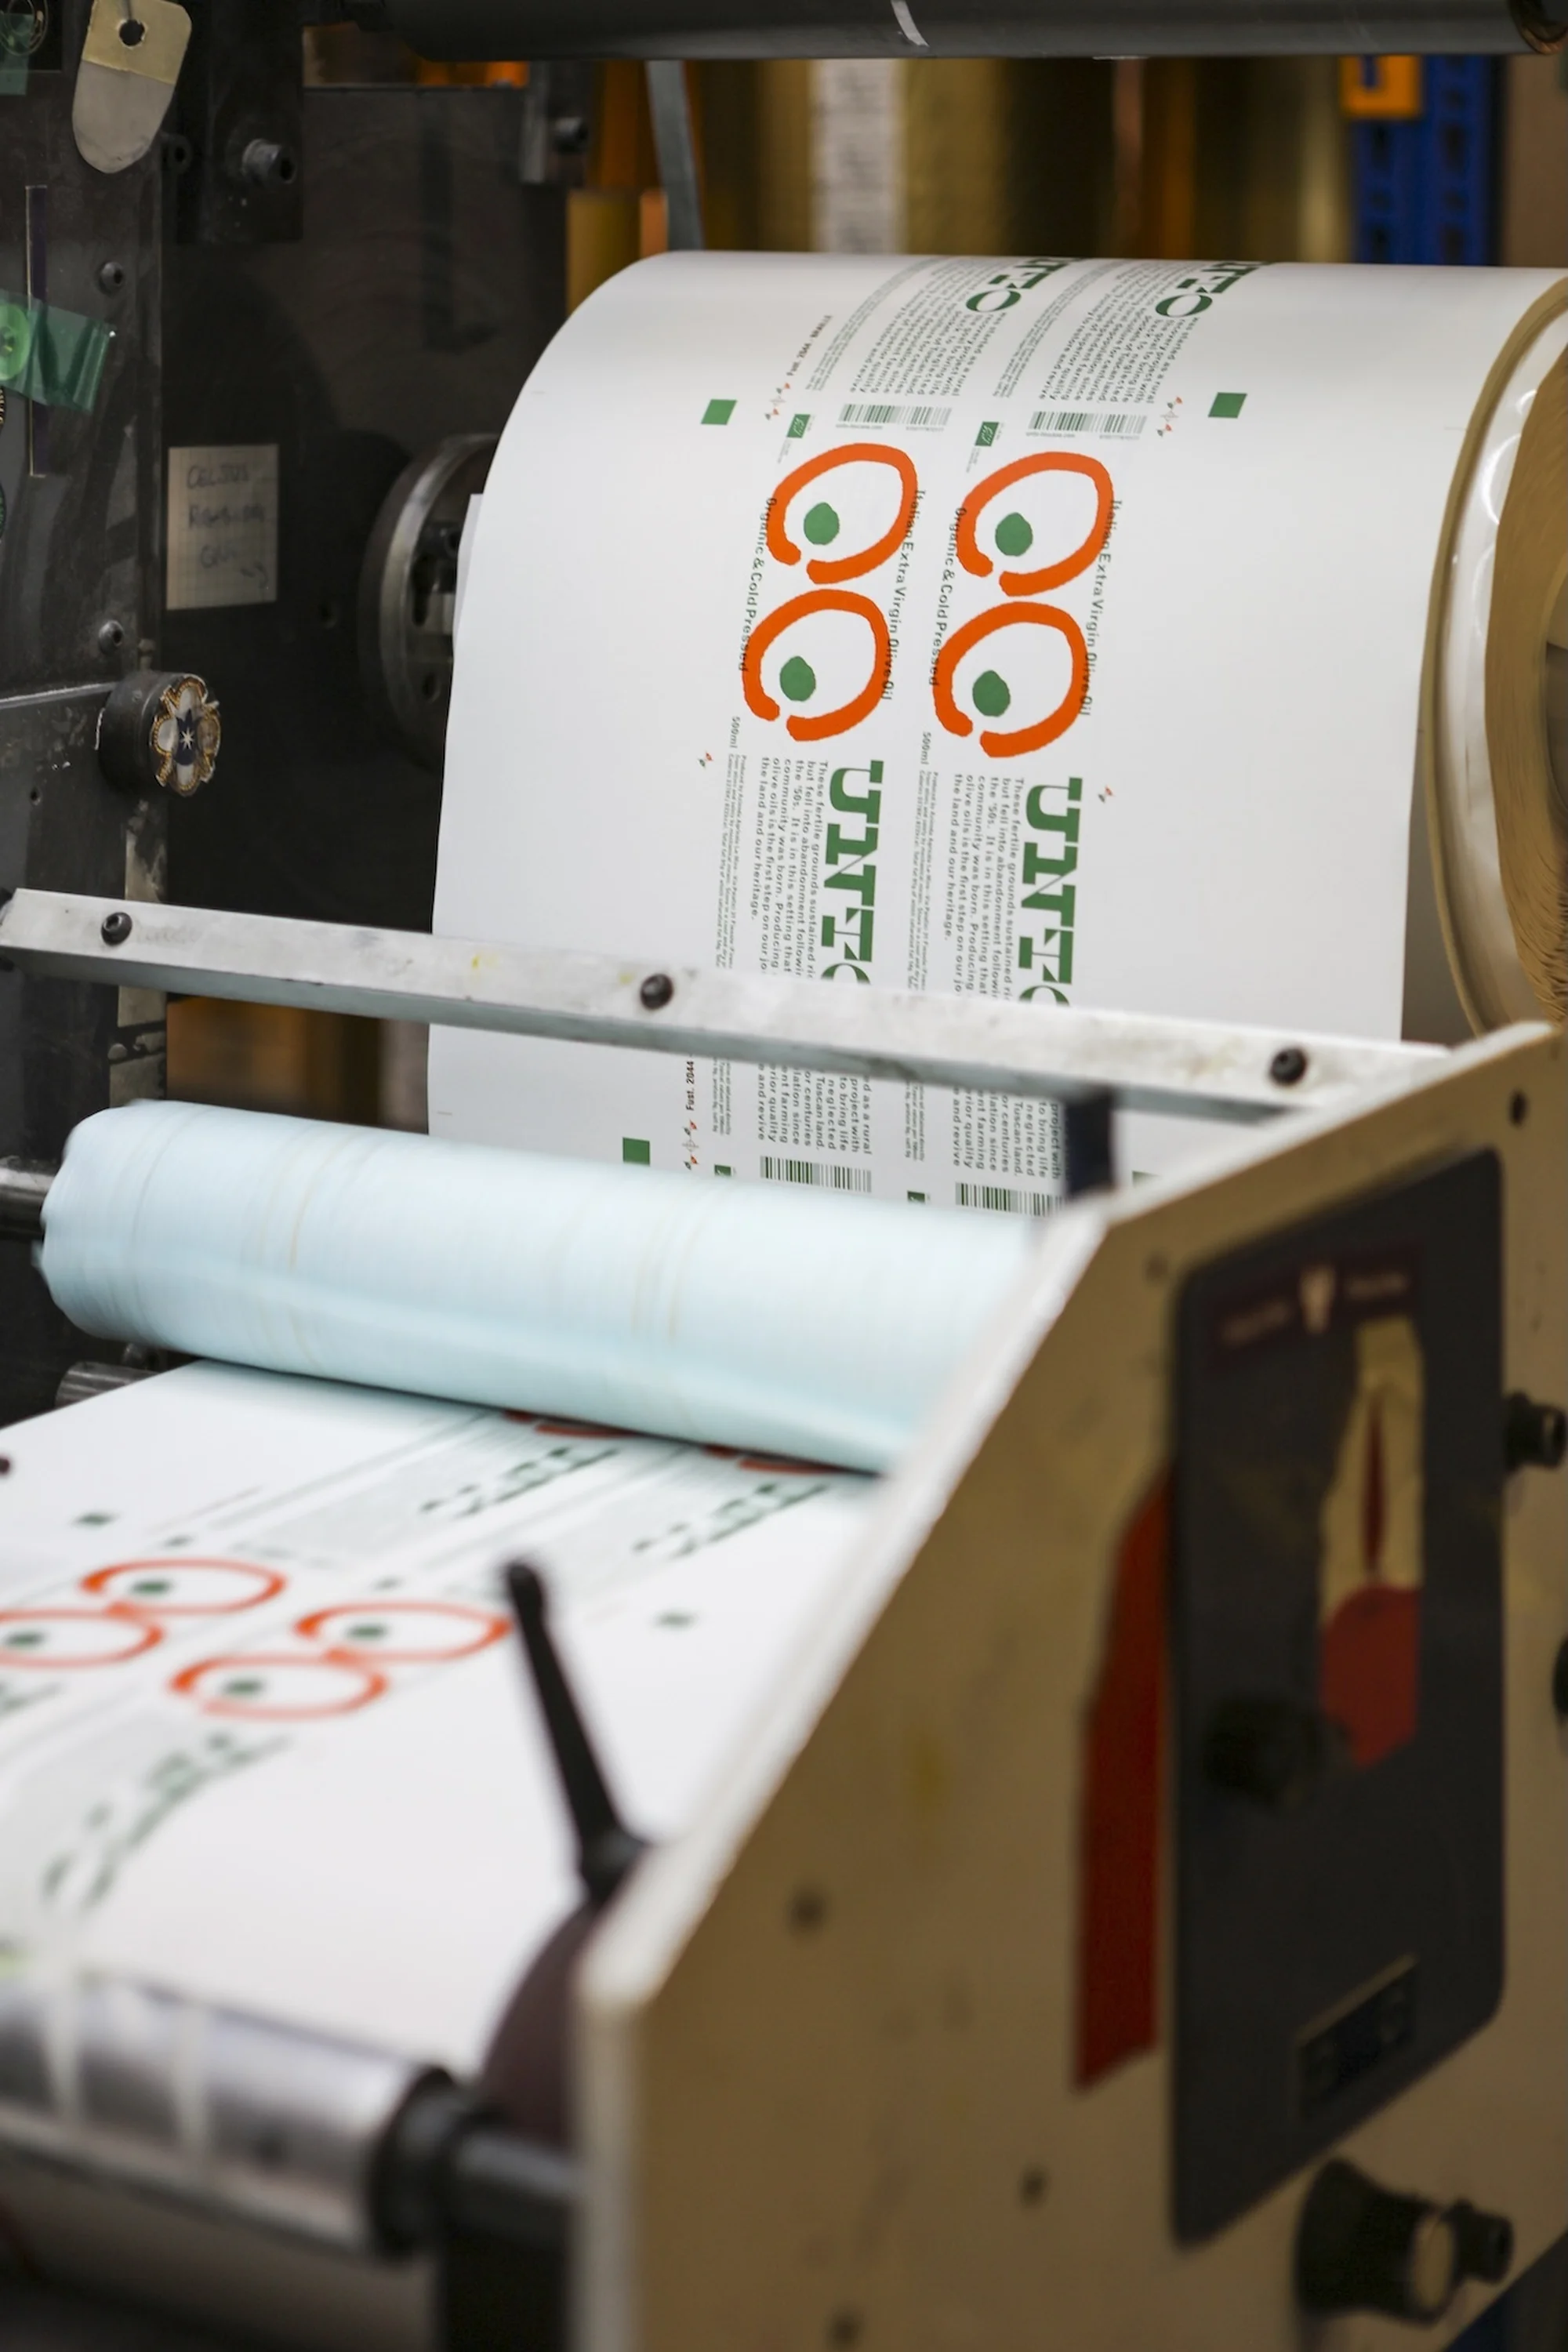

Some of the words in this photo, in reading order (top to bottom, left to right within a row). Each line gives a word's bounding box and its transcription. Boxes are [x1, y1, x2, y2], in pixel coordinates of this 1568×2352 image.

[750, 496, 778, 554] Organic
[903, 489, 927, 538] Italian
[1100, 499, 1123, 550] Italian
[941, 506, 967, 566] Organic
[751, 557, 764, 571] &
[894, 541, 915, 583] Extra
[942, 568, 954, 582] &
[1091, 553, 1112, 596] Extra
[746, 571, 762, 606] Cold
[936, 583, 953, 619] Cold
[886, 585, 906, 633] Virgin
[1083, 597, 1105, 648] Virgin
[737, 608, 756, 672] Pressed
[927, 621, 947, 687] Pressed
[884, 637, 898, 678] Olive
[1082, 652, 1097, 691] Olive
[880, 680, 895, 700] Oil
[1078, 695, 1093, 716] Oil
[729, 716, 740, 748] 500ml
[920, 731, 931, 764] 500ml
[760, 757, 769, 777] the
[771, 757, 781, 789] olive
[794, 760, 804, 780] the
[806, 760, 816, 781] but
[816, 761, 828, 797] These
[757, 780, 768, 808] land
[777, 758, 790, 832] community
[804, 786, 814, 806] fell
[953, 774, 963, 793] the
[964, 775, 974, 806] olive
[989, 777, 999, 797] the
[1001, 778, 1011, 798] but
[1012, 778, 1024, 815] These
[768, 792, 778, 815] oils
[950, 797, 961, 826] land
[971, 775, 985, 850] community
[1000, 804, 1010, 823] fell
[768, 818, 777, 829] is
[791, 818, 800, 826] It
[802, 809, 811, 833] into
[813, 801, 825, 839] fertile
[962, 810, 971, 833] oils
[766, 832, 775, 852] the
[789, 831, 799, 843] is
[949, 829, 957, 854] and
[961, 837, 969, 848] is
[985, 836, 995, 845] It
[997, 827, 1007, 852] into
[1009, 819, 1021, 858] fertile
[764, 855, 775, 880] first
[789, 848, 797, 859] in
[810, 844, 819, 895] grounds
[960, 851, 969, 871] the
[985, 850, 993, 862] is
[775, 865, 785, 897] born.
[787, 865, 797, 889] this
[797, 837, 809, 924] abandonment
[958, 875, 968, 900] first
[984, 866, 993, 879] in
[750, 862, 762, 919] heritage.
[761, 884, 771, 911] step
[967, 884, 980, 918] born.
[982, 884, 992, 909] this
[993, 855, 1005, 945] abandonment
[1007, 862, 1015, 916] grounds
[762, 914, 769, 930] on
[782, 894, 794, 941] setting
[943, 882, 956, 939] heritage.
[956, 904, 966, 932] step
[770, 902, 783, 967] Producing
[807, 898, 817, 961] sustained
[956, 935, 963, 951] on
[978, 914, 989, 962] setting
[783, 946, 792, 972] that
[964, 923, 978, 990] Producing
[1004, 919, 1013, 983] sustained
[979, 967, 988, 994] that
[685, 1061, 694, 1084] 2044
[757, 1074, 766, 1098] and
[839, 1076, 848, 1089] to
[685, 1090, 694, 1110] Fust.
[815, 1076, 825, 1118] Tuscan
[837, 1093, 848, 1127] bring
[849, 1076, 859, 1123] project
[862, 1094, 869, 1109] as
[953, 1098, 961, 1123] and
[1036, 1100, 1048, 1115] to
[767, 1097, 778, 1142] quality
[779, 1091, 789, 1143] farming
[792, 1112, 800, 1145] since
[804, 1087, 812, 1146] centuries
[826, 1079, 836, 1149] neglected
[1013, 1102, 1023, 1144] Tuscan
[1048, 1102, 1062, 1149] project
[815, 1120, 824, 1149] land.
[840, 1131, 848, 1151] life
[862, 1123, 872, 1154] rural
[953, 1126, 961, 1166] revive
[963, 1122, 974, 1168] quality
[975, 1116, 986, 1169] farming
[1001, 1112, 1010, 1172] centuries
[1024, 1104, 1035, 1176] neglected
[1036, 1119, 1047, 1152] bring
[989, 1138, 997, 1171] since
[1014, 1146, 1023, 1175] land.
[1039, 1156, 1048, 1177] life
[1051, 1152, 1063, 1180] with
